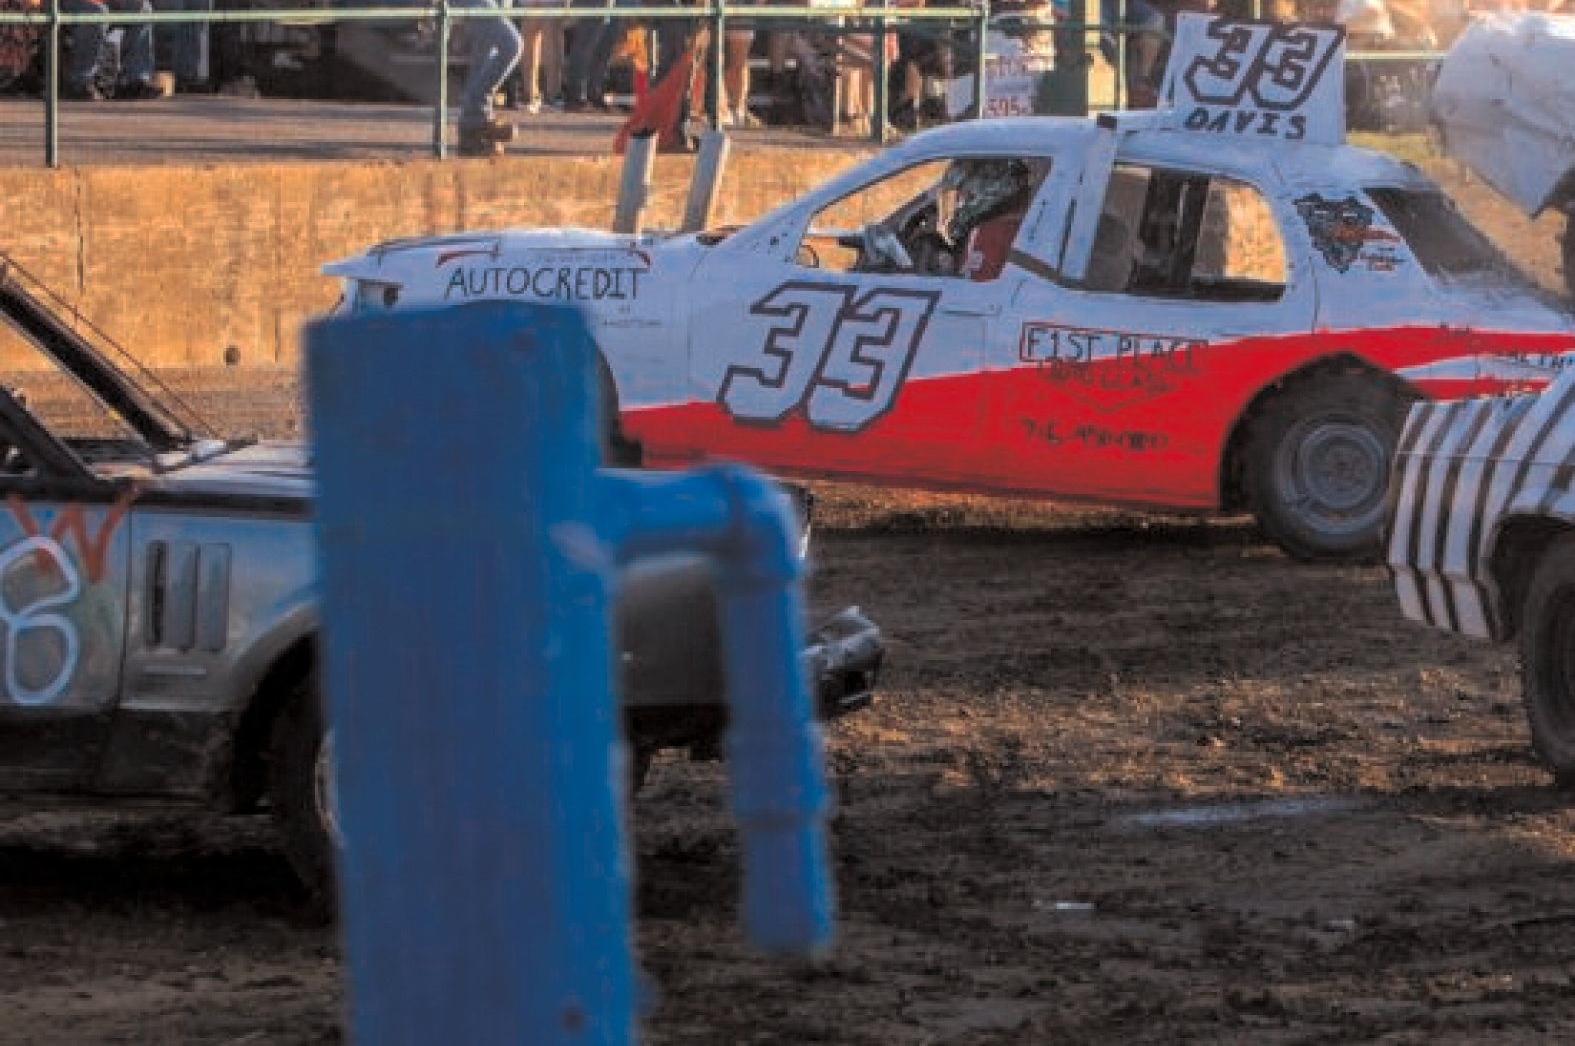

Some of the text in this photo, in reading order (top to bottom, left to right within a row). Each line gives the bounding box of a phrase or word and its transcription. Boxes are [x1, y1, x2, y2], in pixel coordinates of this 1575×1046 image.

[1184, 107, 1306, 140] DAVIS
[443, 267, 648, 301] AUTOCREDIT
[716, 281, 941, 433] 33
